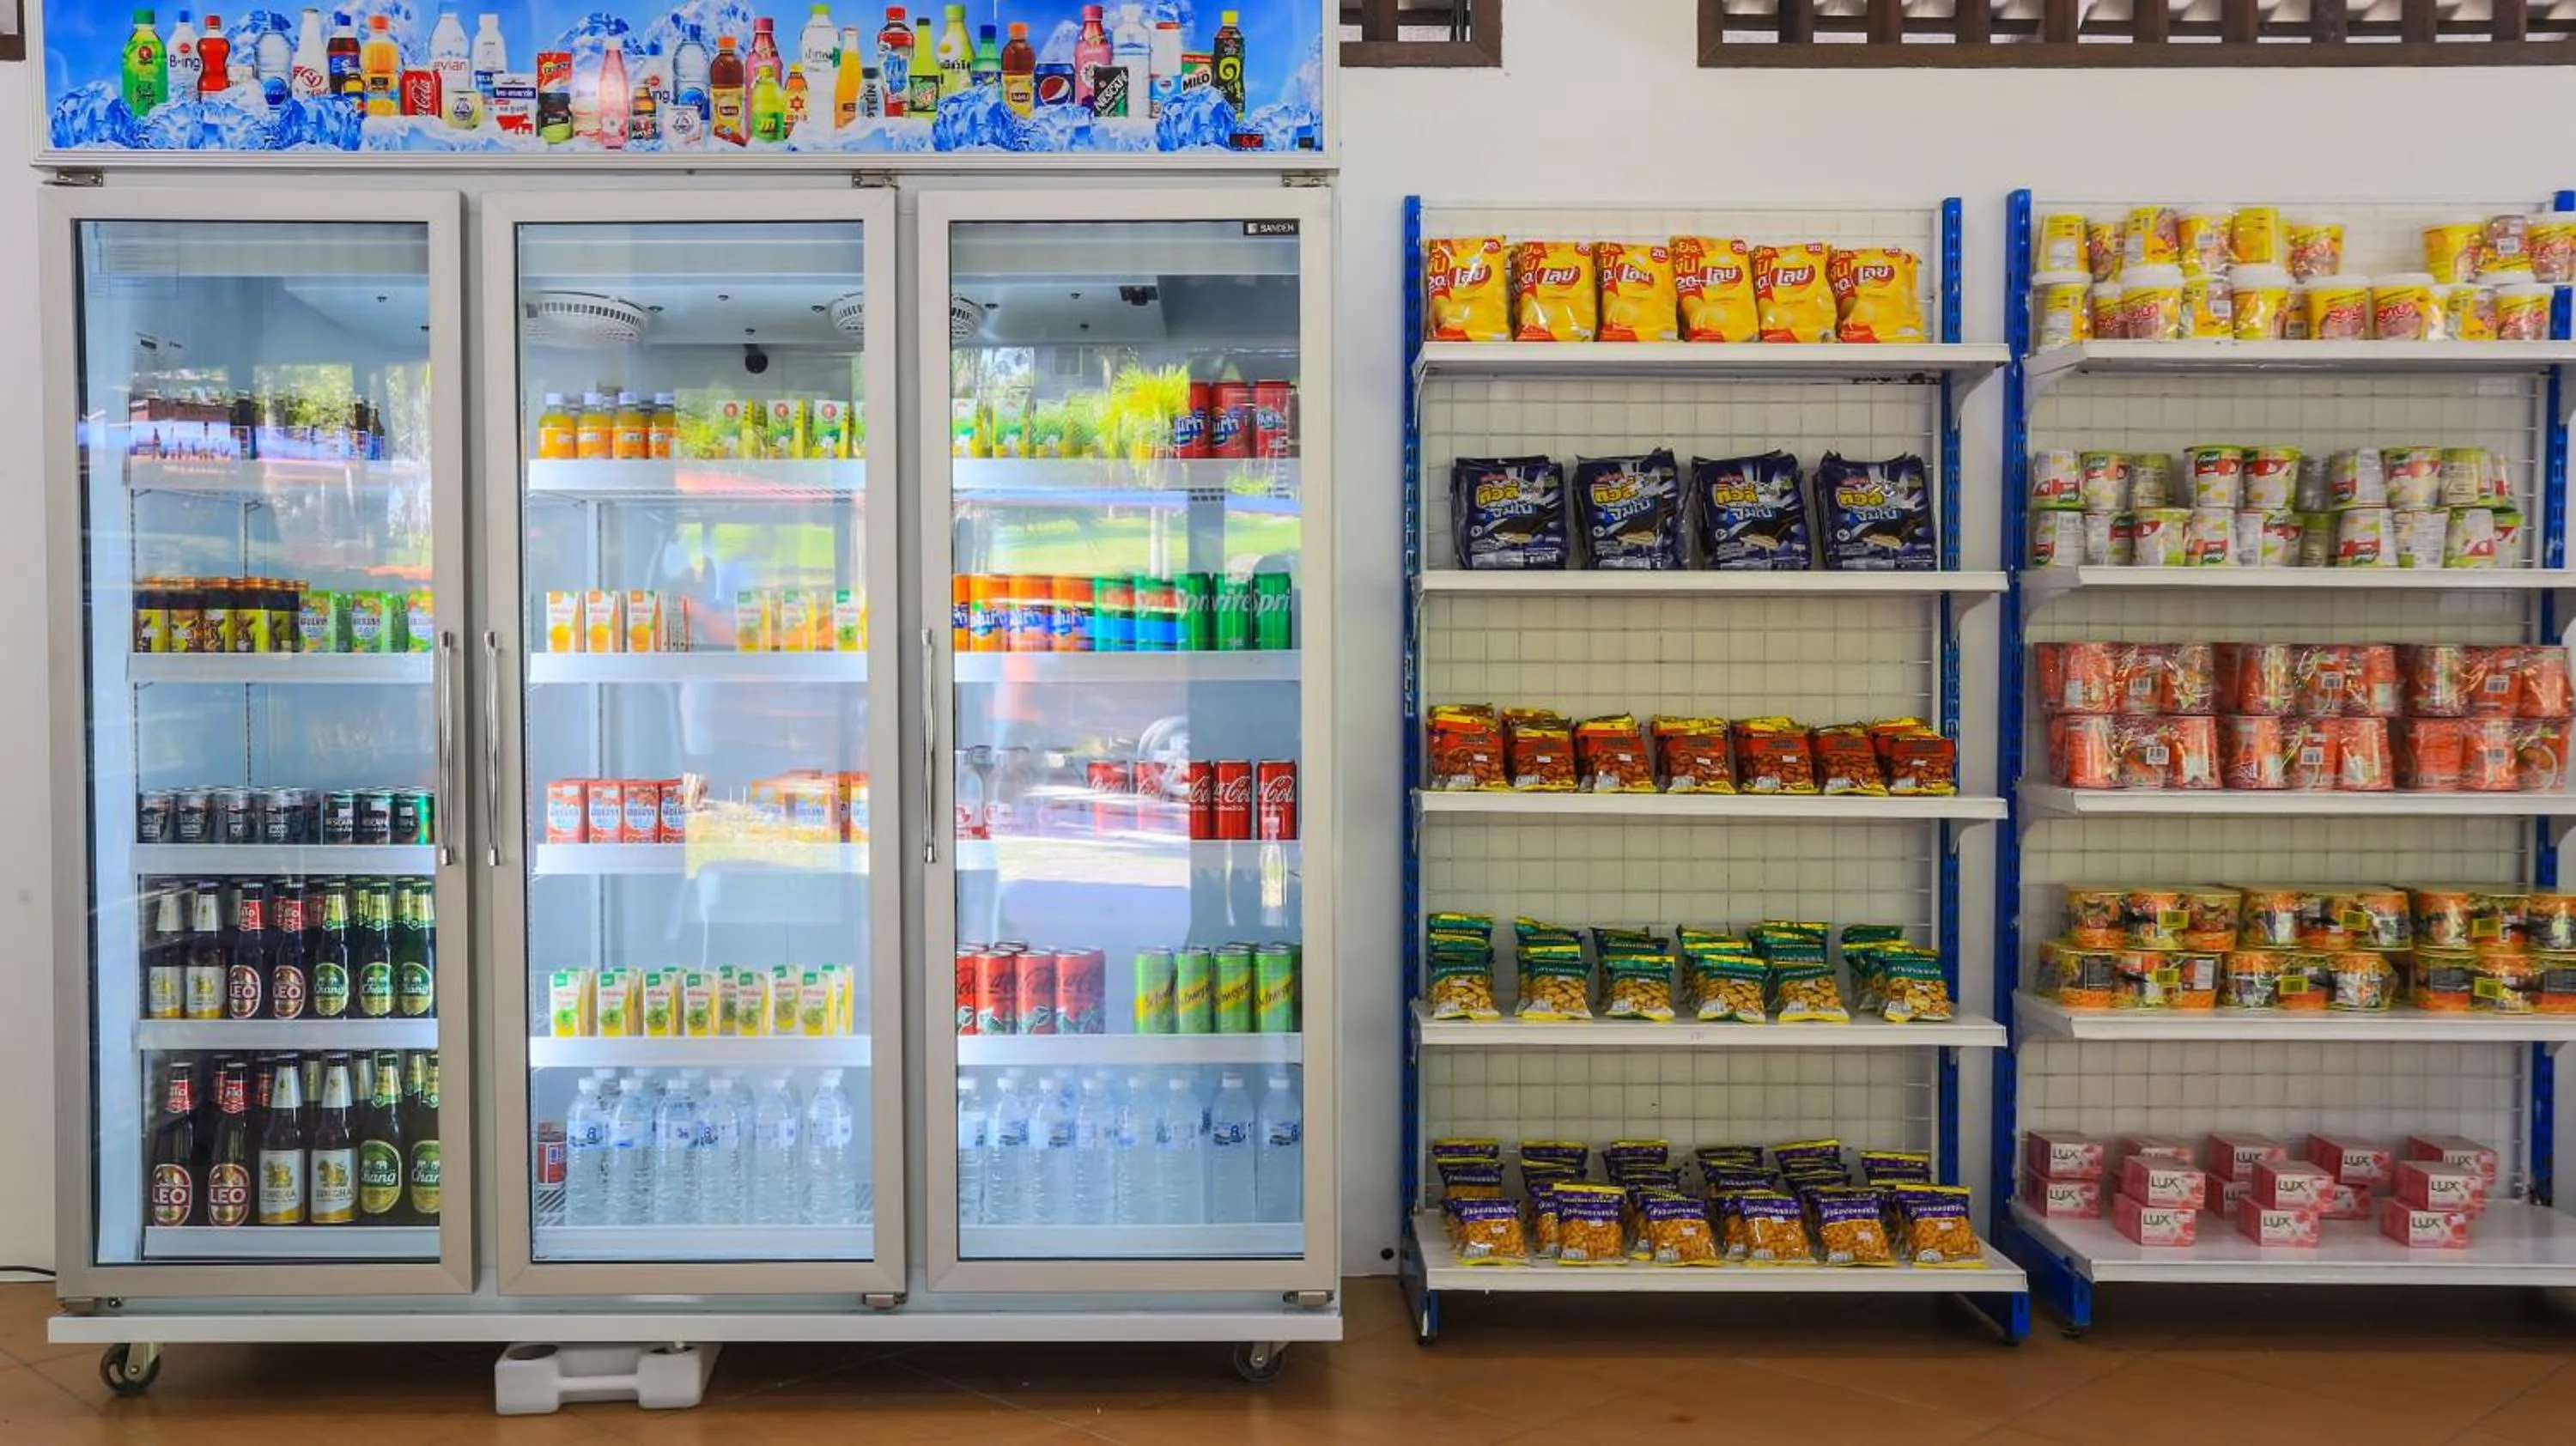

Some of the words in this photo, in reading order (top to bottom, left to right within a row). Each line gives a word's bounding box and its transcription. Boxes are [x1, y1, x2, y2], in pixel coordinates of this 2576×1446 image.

[1182, 73, 1211, 91] MILO
[1260, 224, 1295, 233] SANDEN
[229, 984, 256, 999] LEO
[273, 984, 301, 999] LEO
[2052, 1148, 2079, 1159] LUX
[2236, 1151, 2262, 1163] LUX
[2344, 1155, 2370, 1166] LUX
[2445, 1155, 2472, 1166] LUX
[2151, 1176, 2178, 1189] LUX
[2278, 1180, 2307, 1192] LUX
[2431, 1180, 2460, 1192] LUX
[152, 1187, 187, 1204] LEO
[210, 1187, 246, 1204] LEO
[2050, 1188, 2076, 1201] LUX
[2143, 1213, 2172, 1225] LUX
[2263, 1216, 2291, 1228] LUX
[2412, 1216, 2440, 1229] LUX
